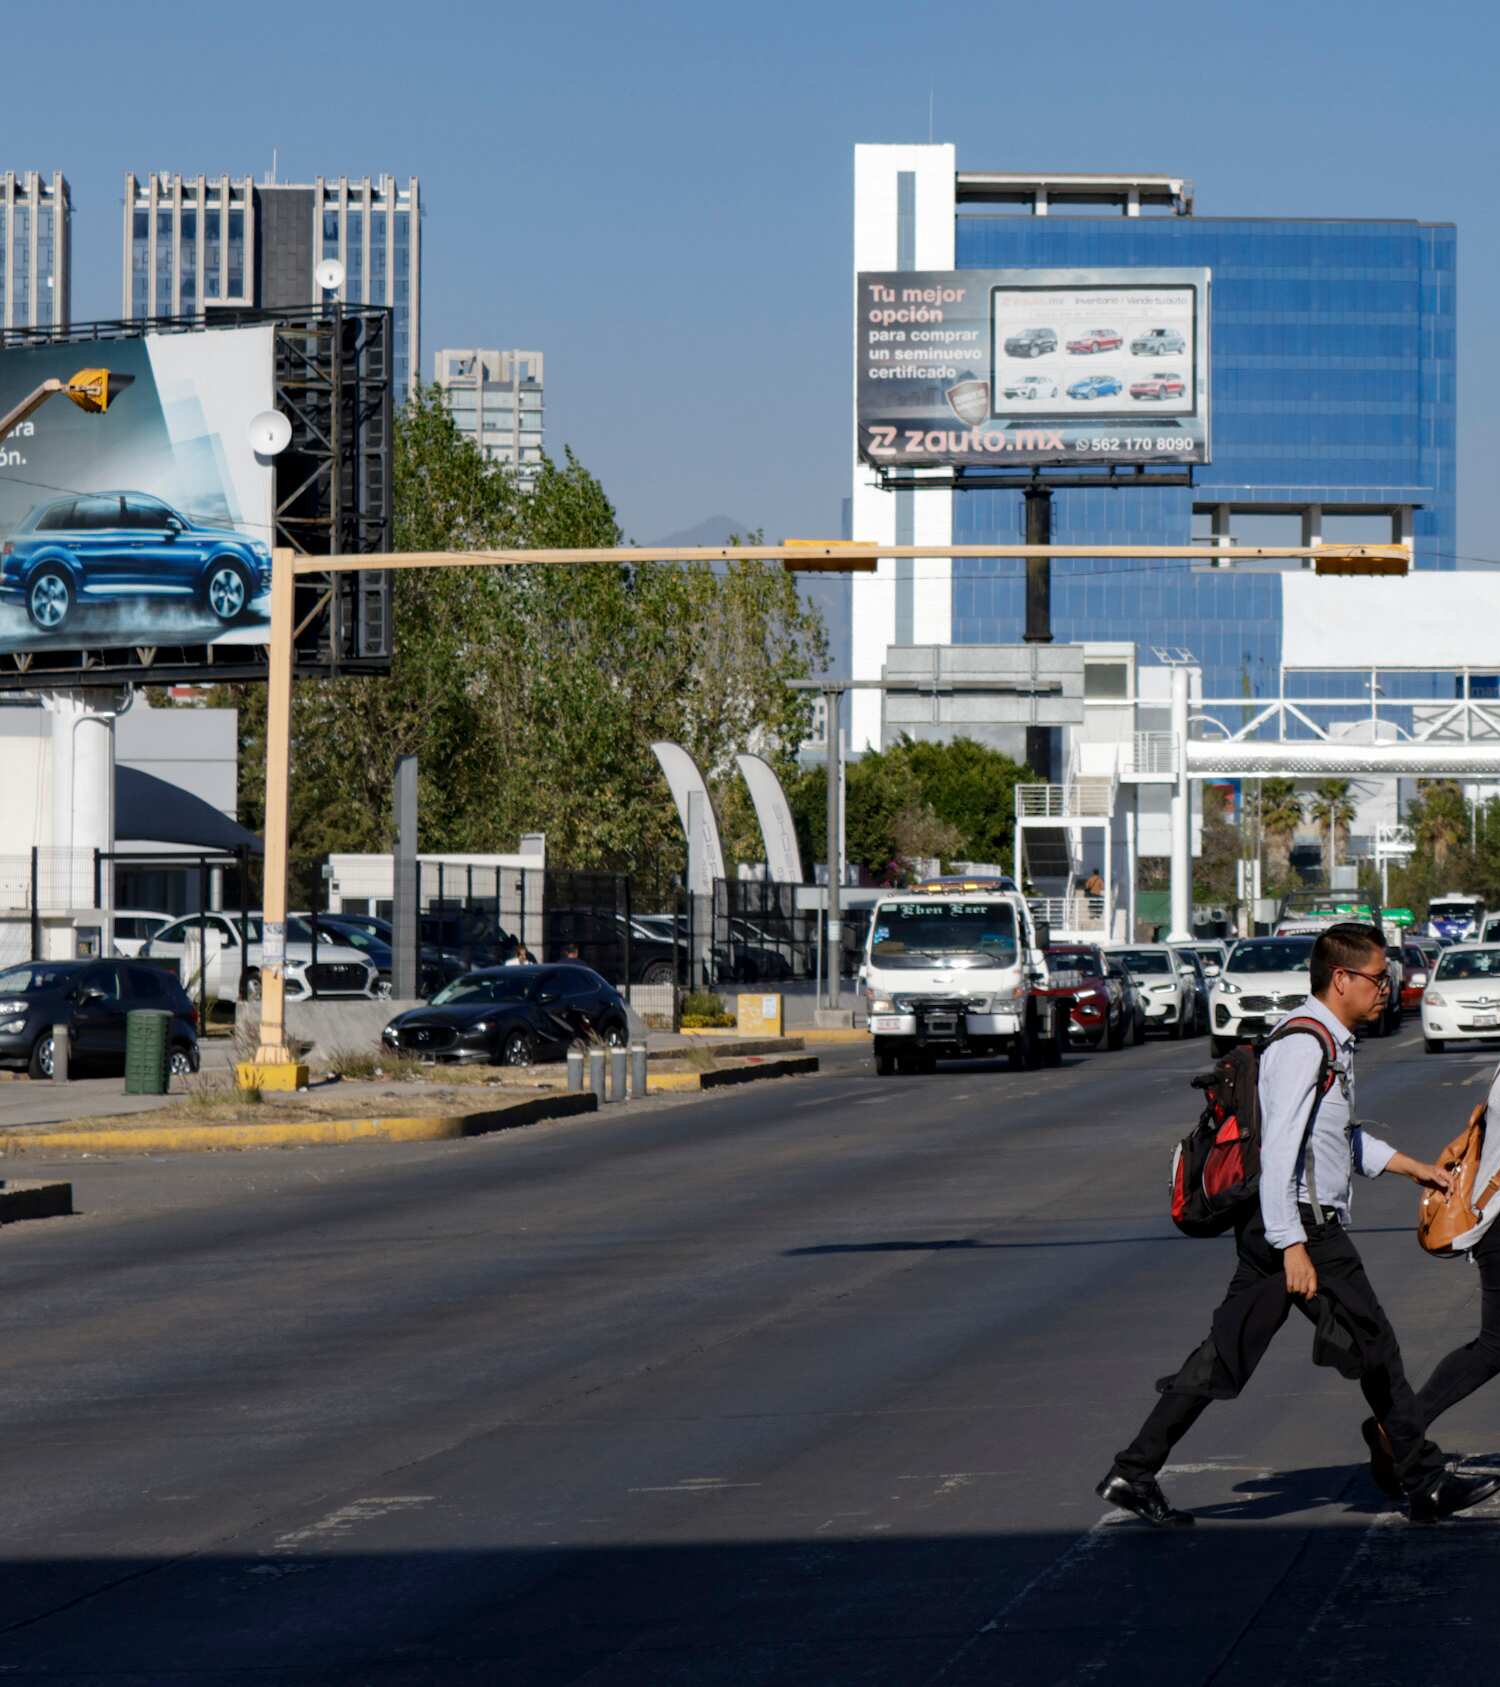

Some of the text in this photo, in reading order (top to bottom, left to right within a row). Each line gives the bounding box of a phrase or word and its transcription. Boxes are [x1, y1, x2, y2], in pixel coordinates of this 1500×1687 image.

[869, 285, 966, 306] Tu mejor
[868, 305, 944, 327] opción
[869, 330, 979, 344] para comprar
[869, 346, 982, 360] un seminuevo
[868, 365, 957, 379] certificado
[6, 421, 35, 439] ra
[904, 425, 1065, 452] zauto.mx
[1091, 437, 1194, 451] 562 170 8090
